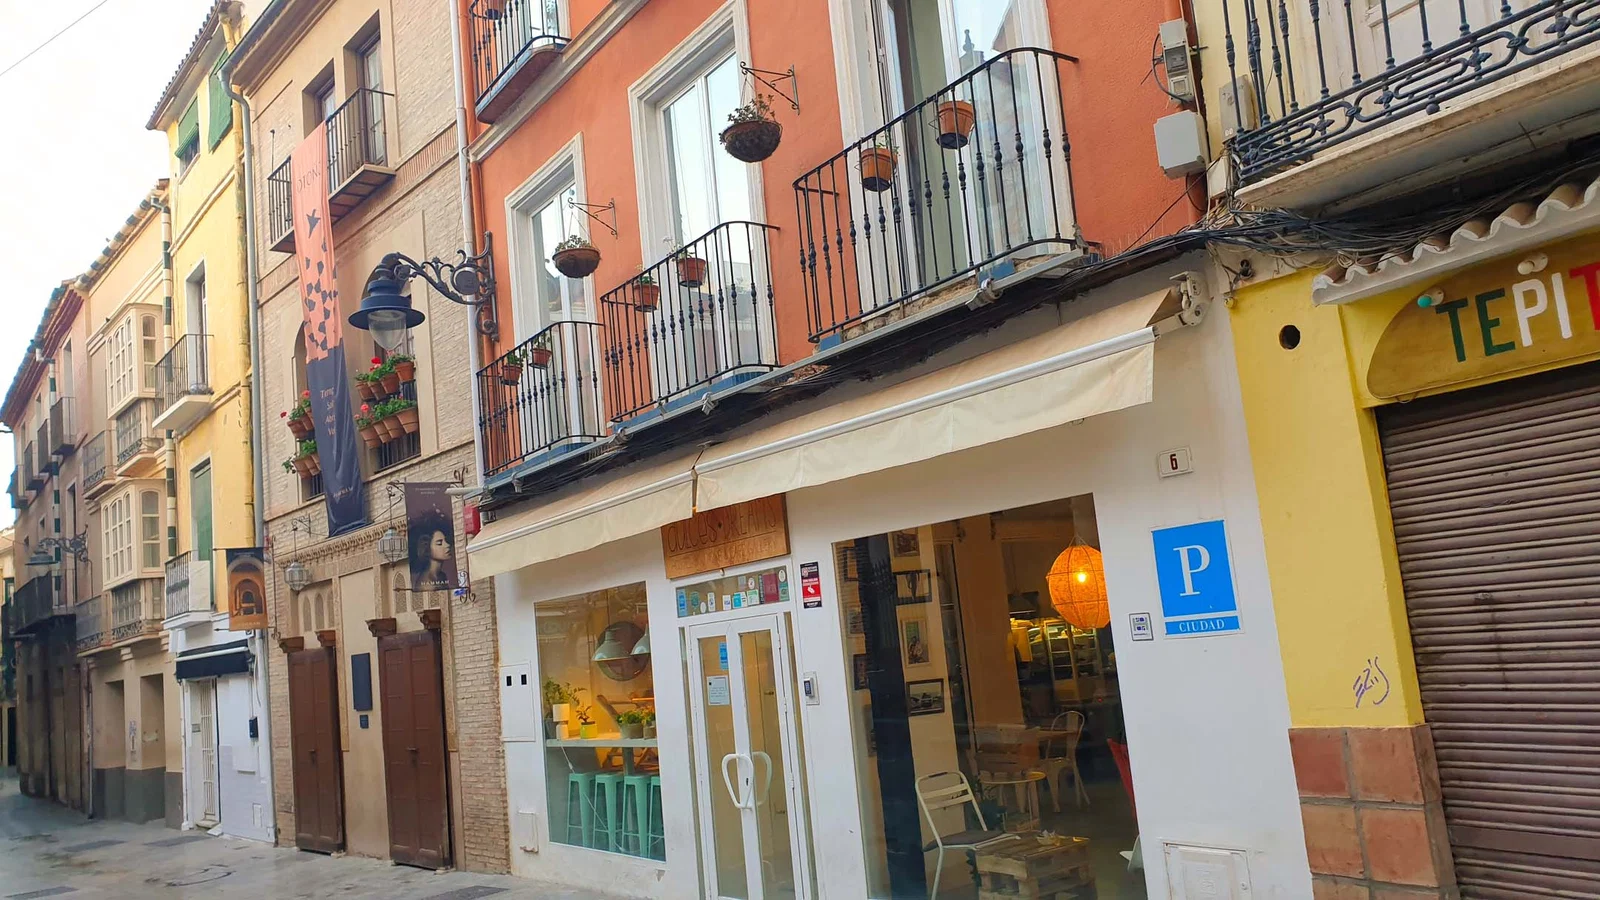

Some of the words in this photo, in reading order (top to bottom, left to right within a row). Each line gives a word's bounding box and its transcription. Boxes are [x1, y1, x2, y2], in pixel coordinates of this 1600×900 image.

[1169, 453, 1179, 471] 6
[1173, 544, 1211, 597] P
[1178, 618, 1225, 633] CIUDAD
